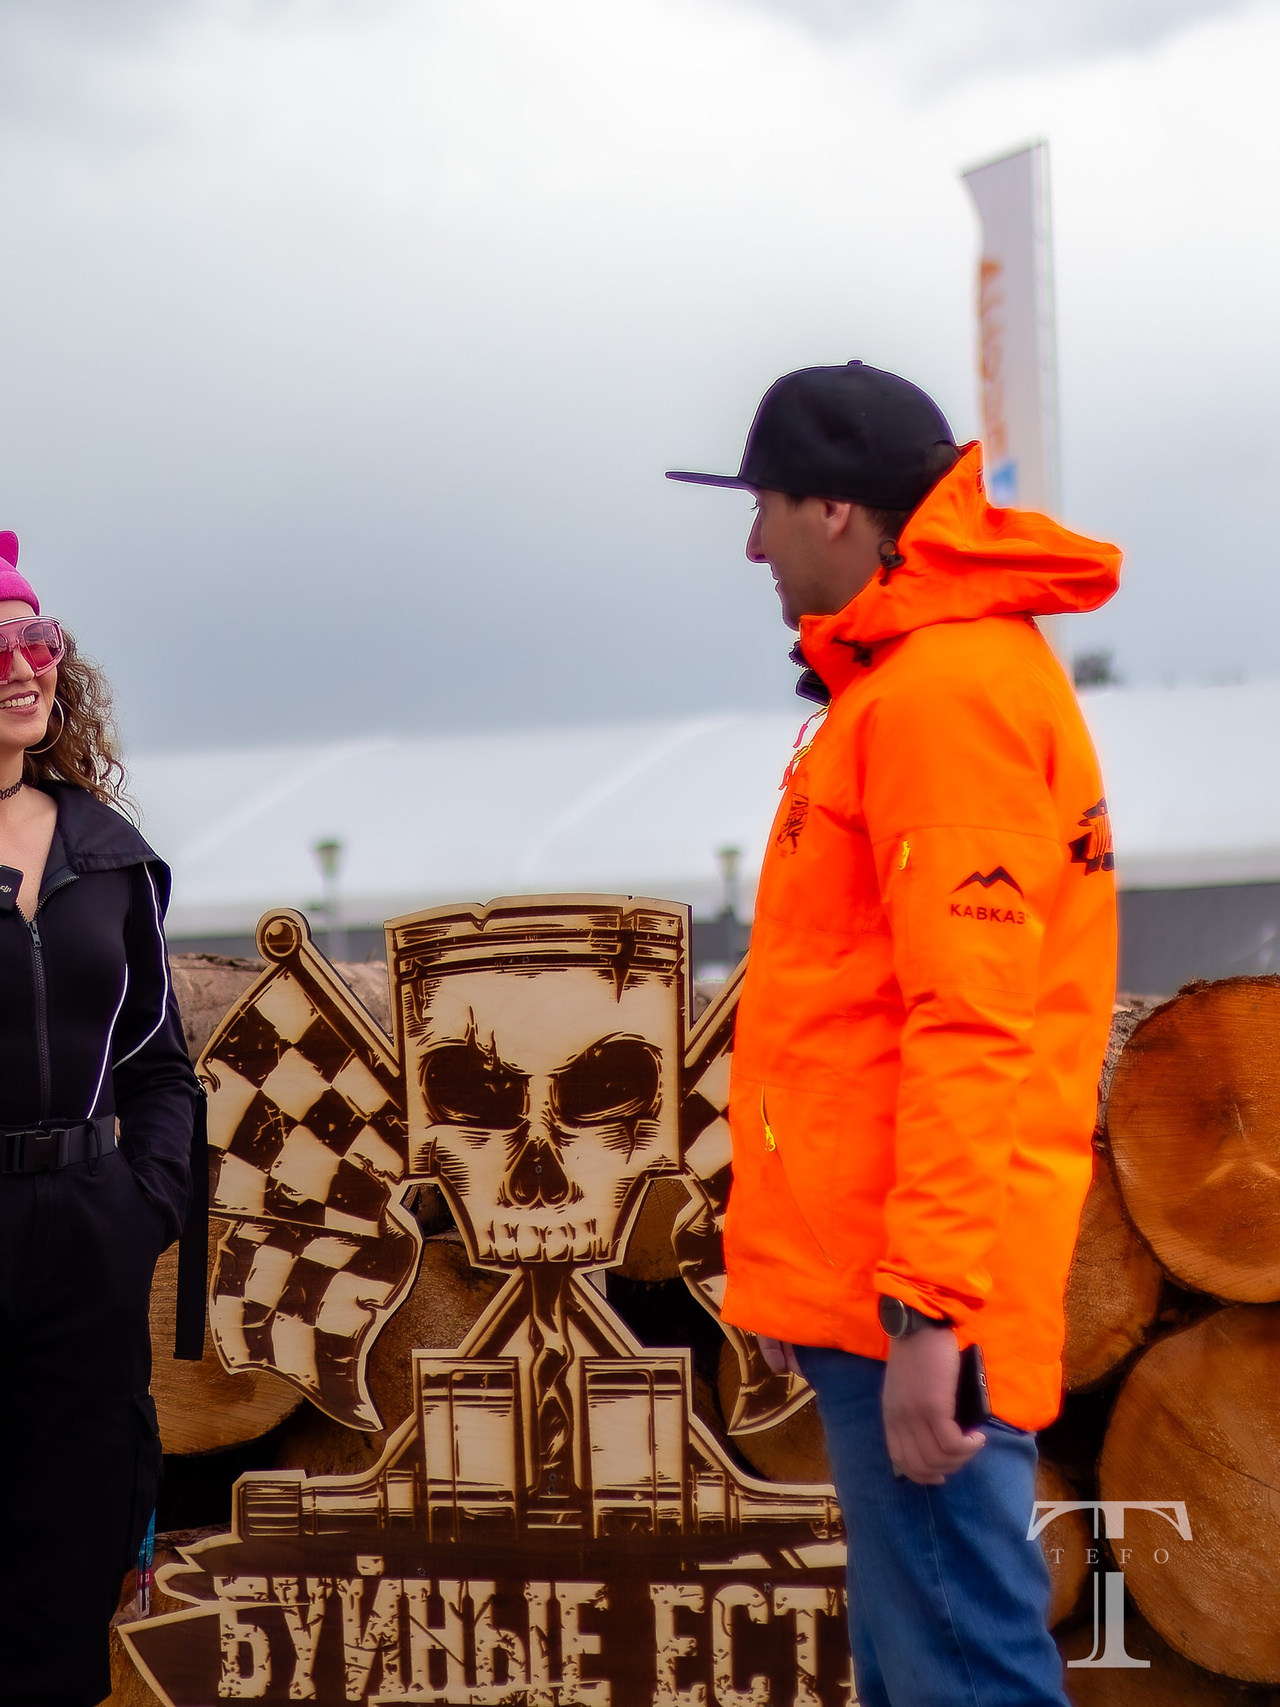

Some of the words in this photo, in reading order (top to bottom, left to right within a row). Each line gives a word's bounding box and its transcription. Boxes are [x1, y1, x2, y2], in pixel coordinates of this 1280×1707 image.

[950, 903, 1026, 925] КАВКАЗ
[213, 1555, 612, 1707] БУЙНЫЕ
[649, 1584, 858, 1707] ЕСТ
